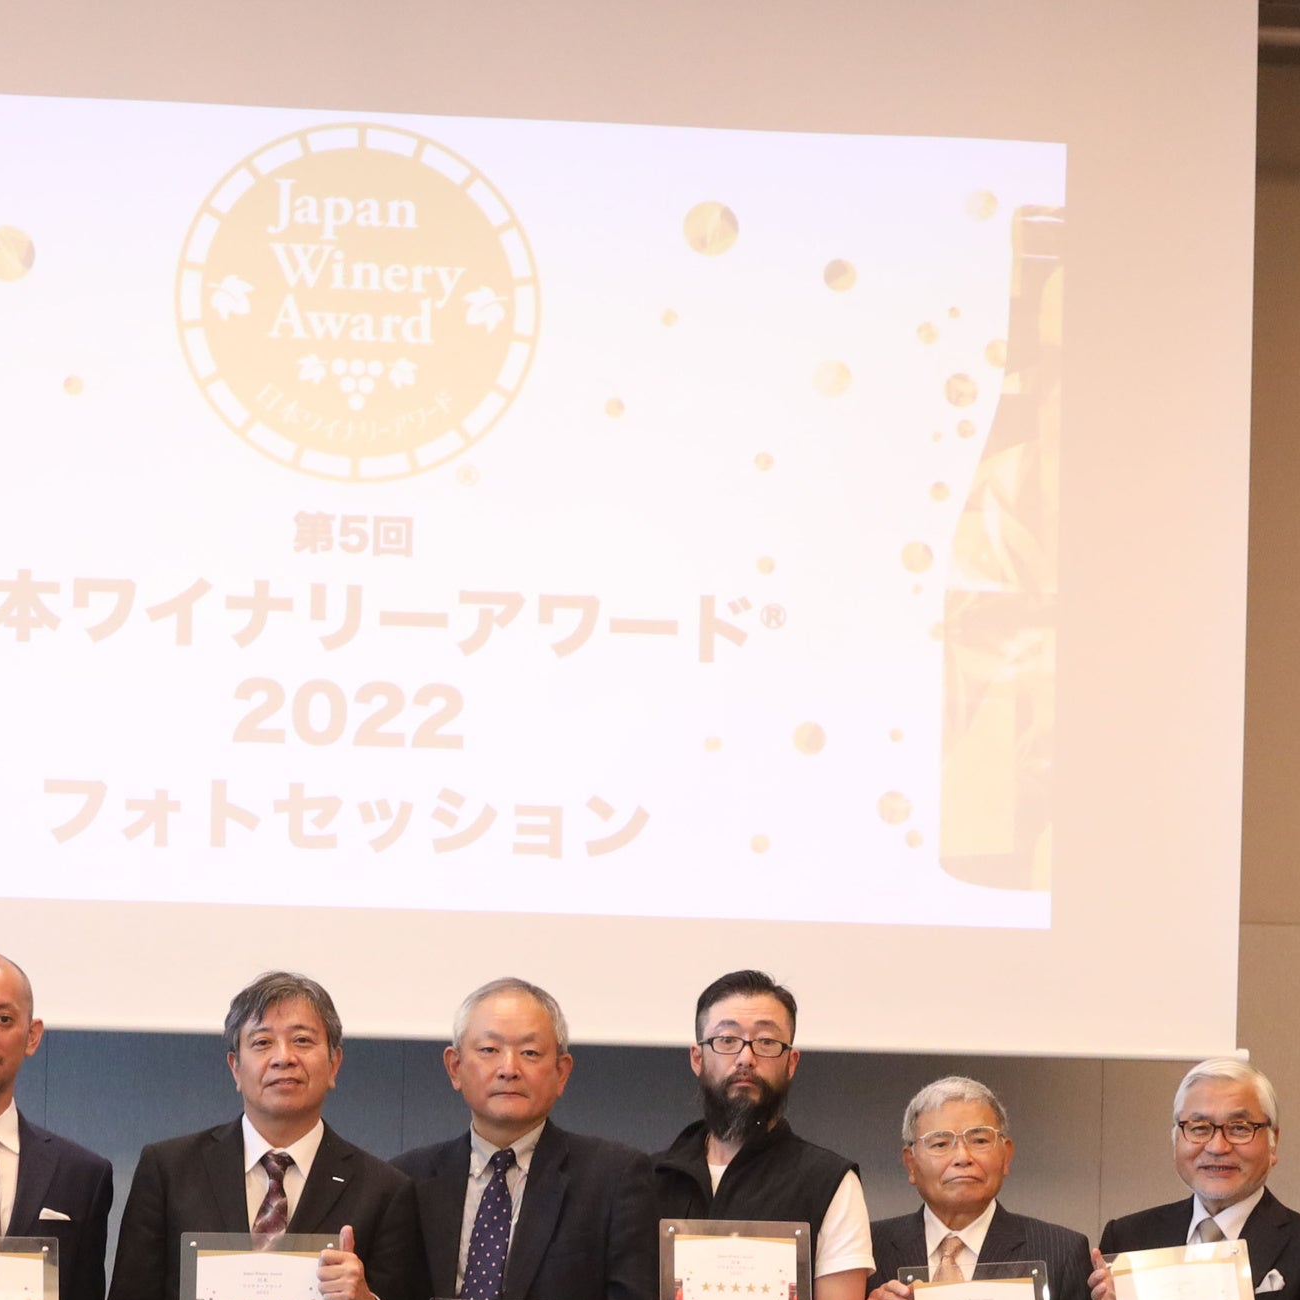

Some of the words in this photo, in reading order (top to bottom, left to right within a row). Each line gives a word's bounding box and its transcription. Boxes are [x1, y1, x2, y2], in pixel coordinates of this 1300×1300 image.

[267, 177, 419, 240] Japan
[268, 242, 466, 308] Winery
[267, 292, 435, 344] Award
[293, 511, 415, 558] 第5回
[231, 677, 465, 750] 2022
[42, 778, 651, 860] フォトセッション
